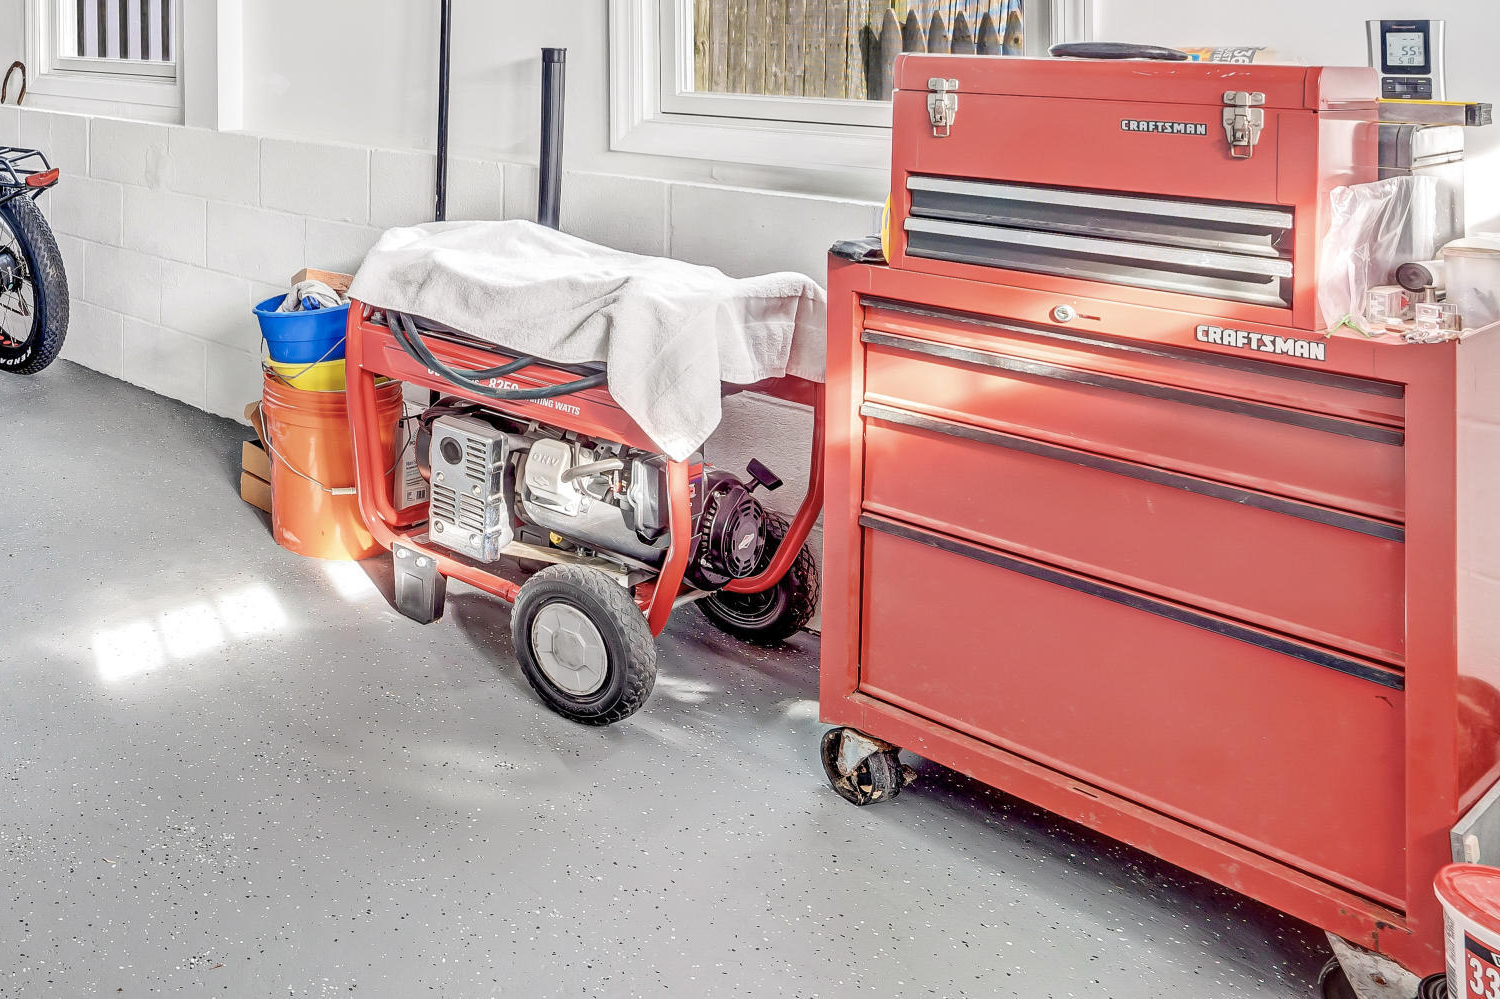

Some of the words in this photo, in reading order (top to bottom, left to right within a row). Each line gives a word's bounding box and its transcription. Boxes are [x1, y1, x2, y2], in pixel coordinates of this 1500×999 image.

[1121, 120, 1207, 135] CRAFTSMAN
[1196, 324, 1326, 361] CRAFTSMAN
[0, 346, 32, 366] KENDA
[555, 401, 580, 416] WATTS
